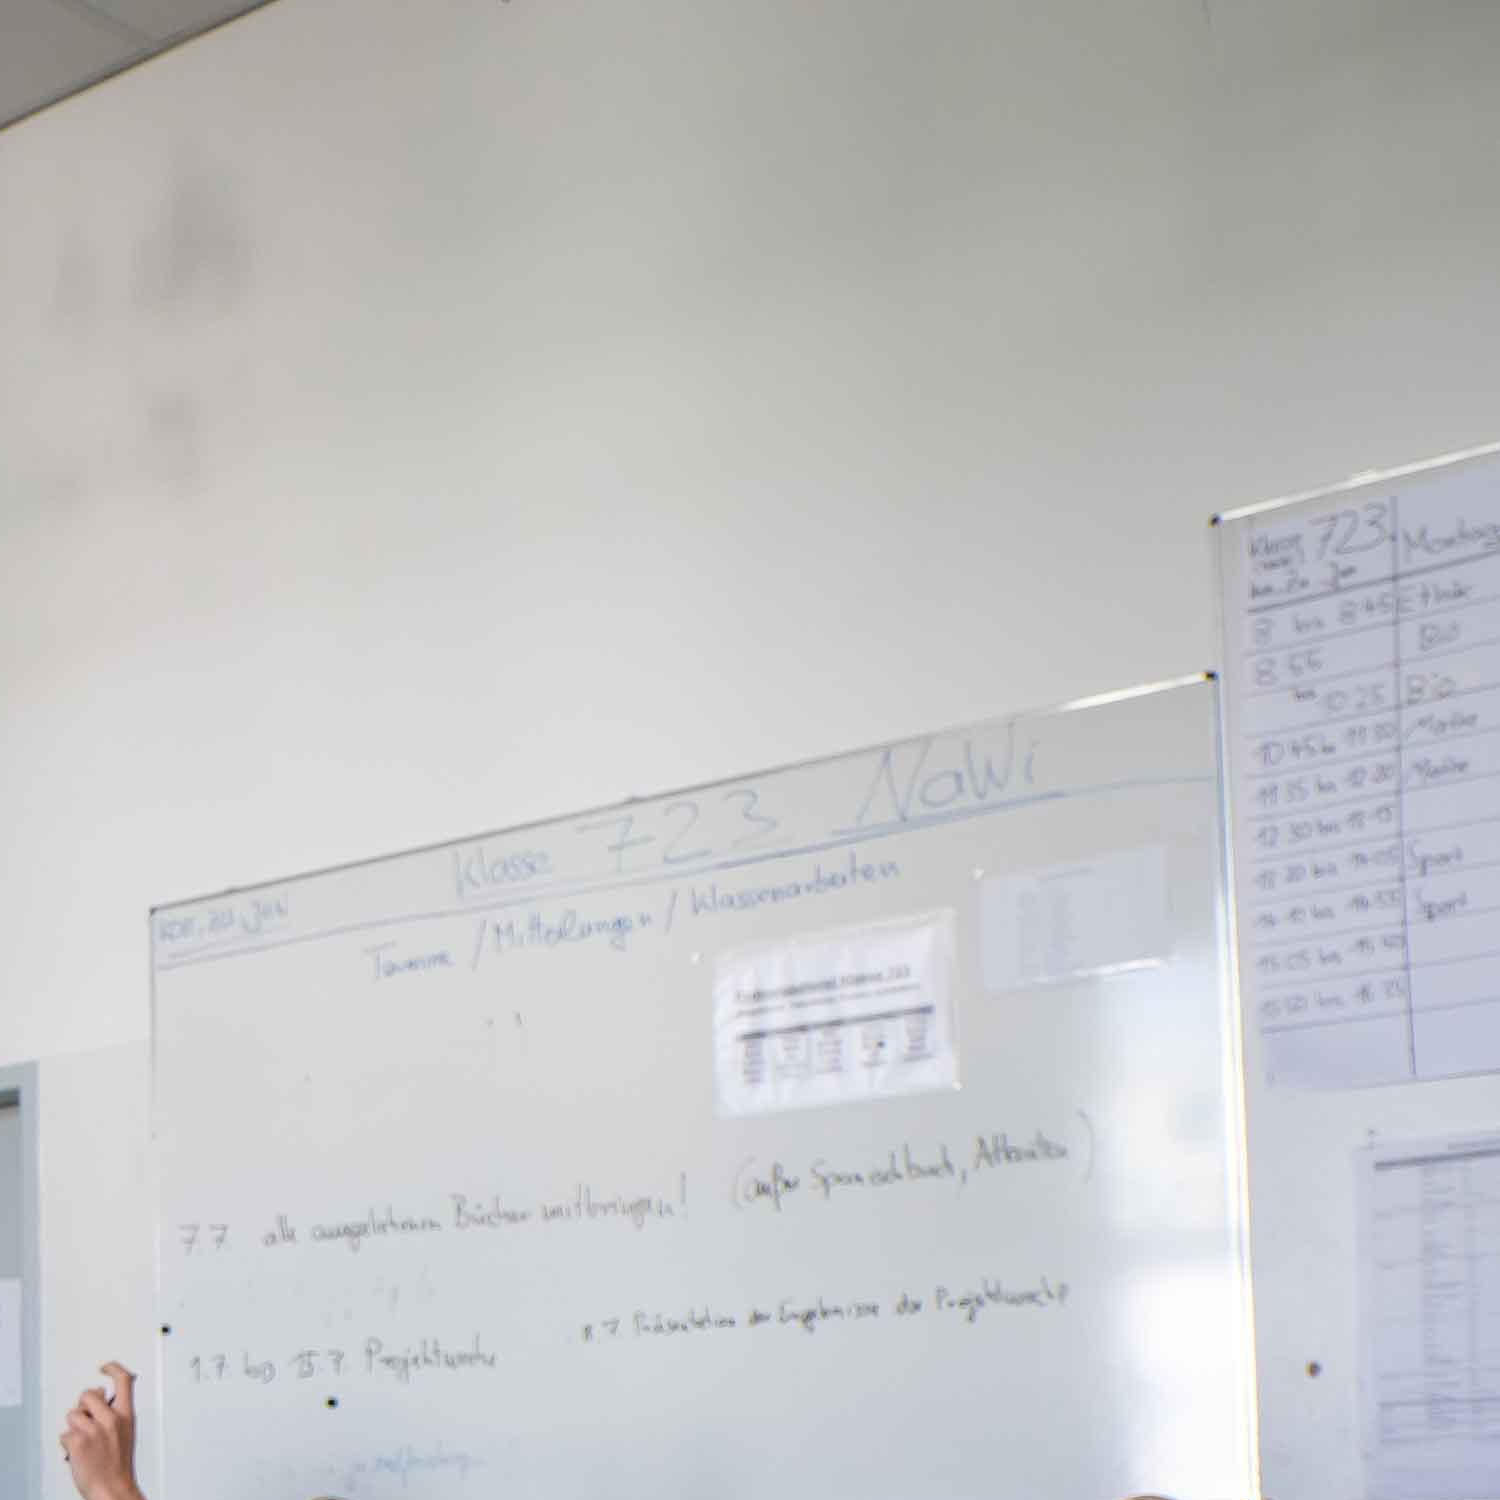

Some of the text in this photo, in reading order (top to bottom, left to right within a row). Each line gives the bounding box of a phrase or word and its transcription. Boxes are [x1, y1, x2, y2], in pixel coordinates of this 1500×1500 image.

[1310, 502, 1389, 561] 723
[453, 720, 1038, 899] Klasse 723 NaWi
